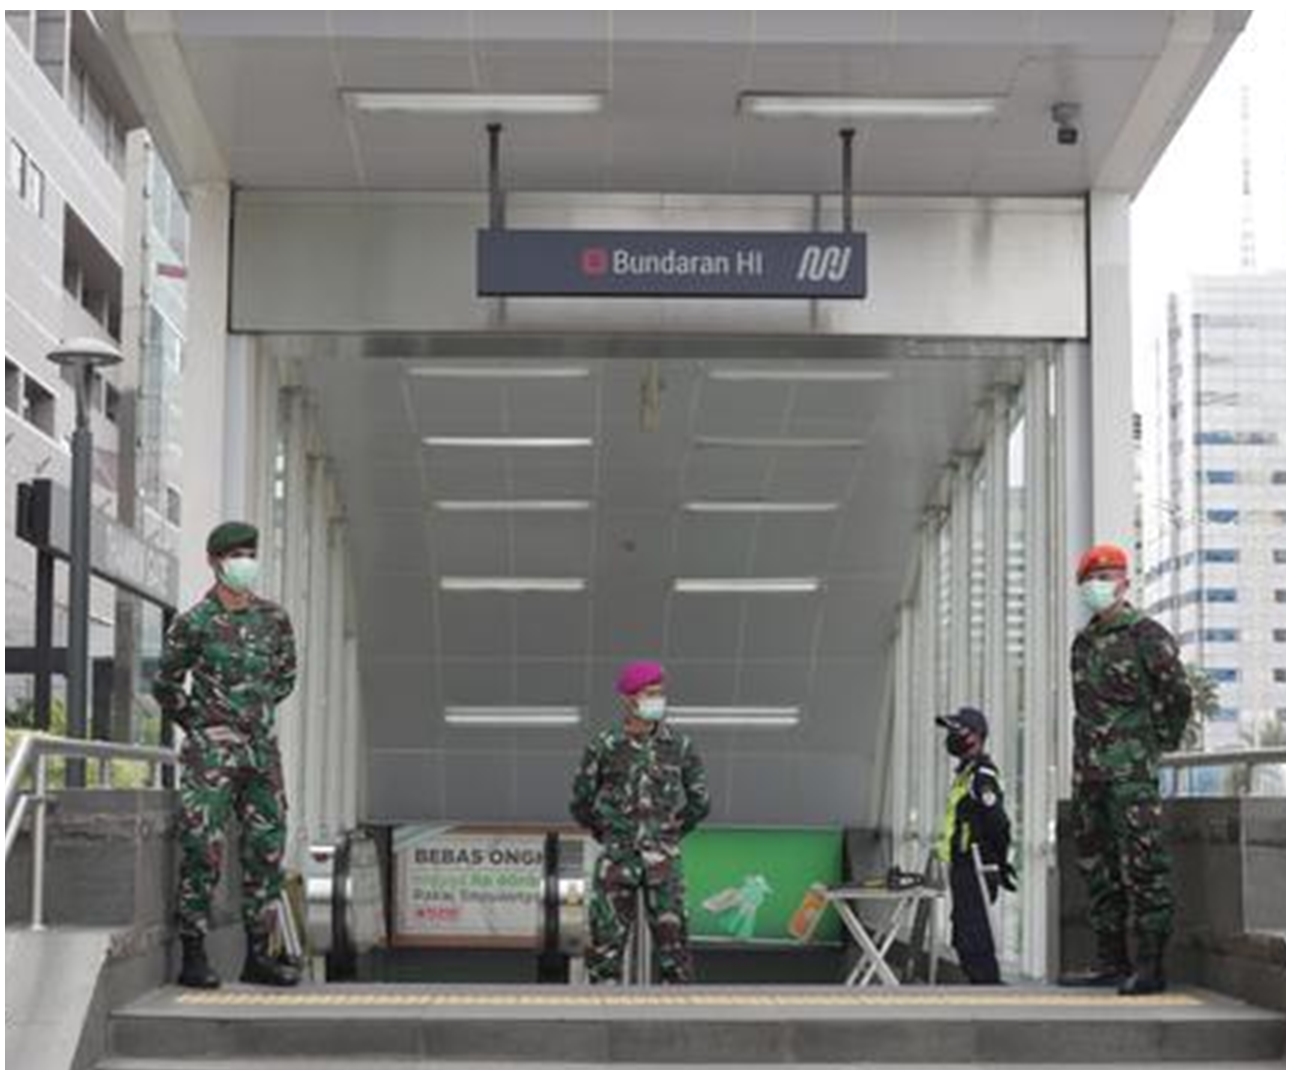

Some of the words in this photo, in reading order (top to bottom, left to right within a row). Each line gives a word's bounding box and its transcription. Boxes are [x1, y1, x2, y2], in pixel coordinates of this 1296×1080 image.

[613, 250, 729, 275] Bundaran
[736, 251, 762, 275] HI
[415, 848, 484, 864] BEBAS
